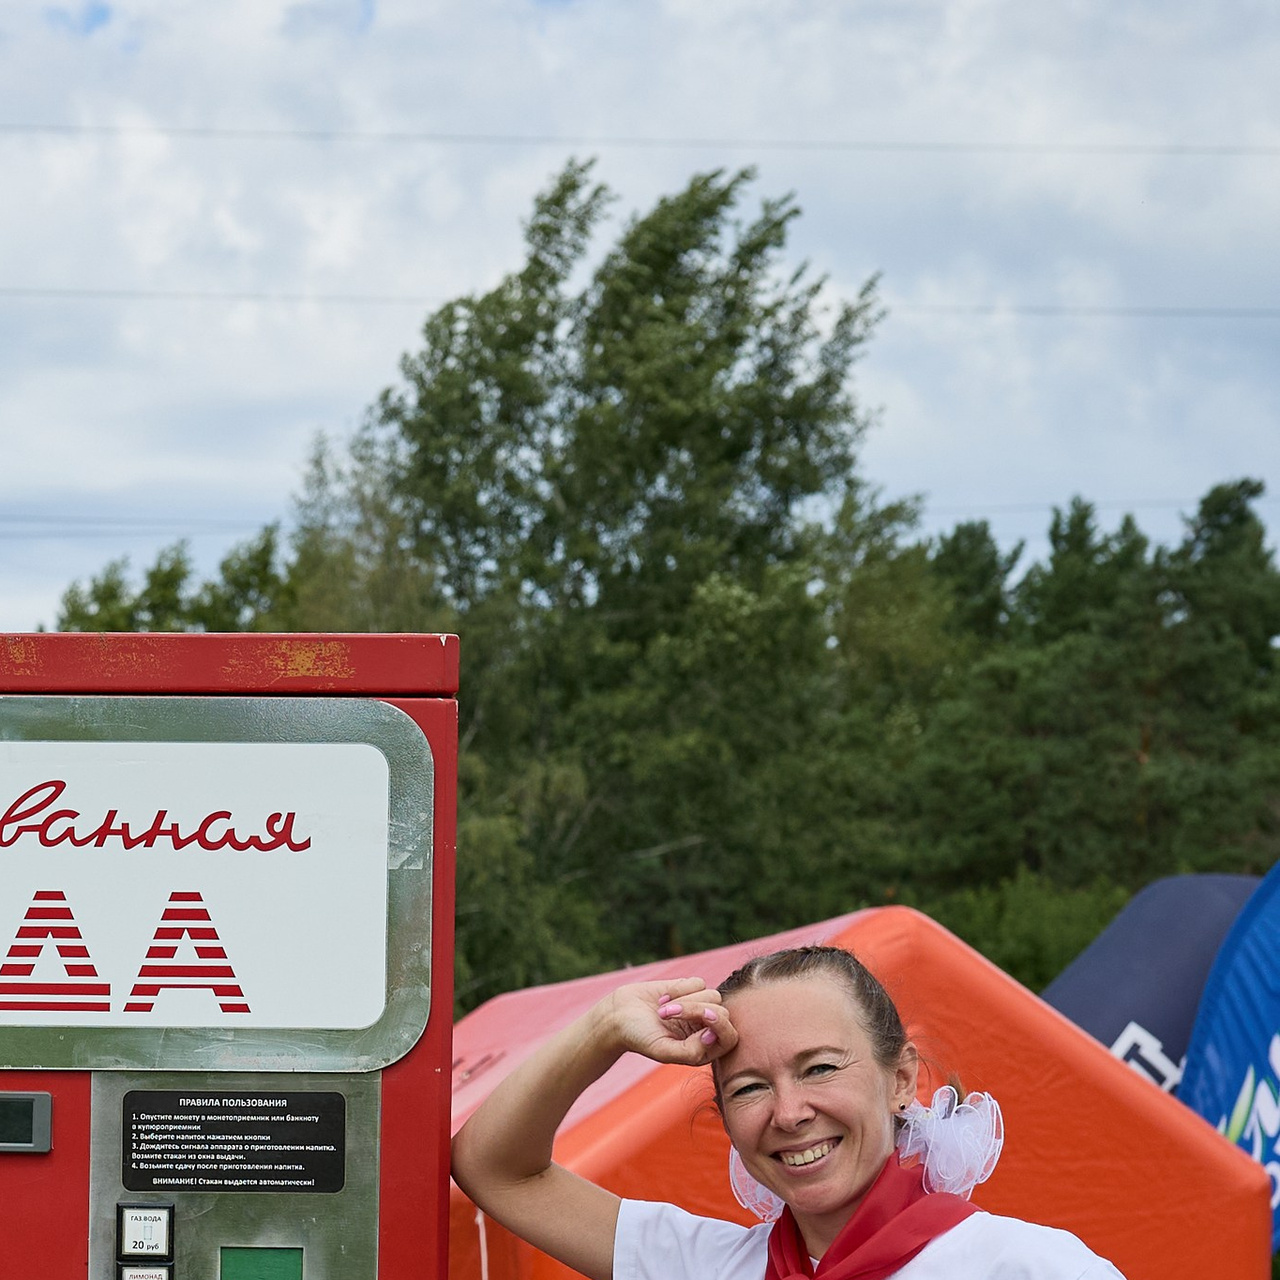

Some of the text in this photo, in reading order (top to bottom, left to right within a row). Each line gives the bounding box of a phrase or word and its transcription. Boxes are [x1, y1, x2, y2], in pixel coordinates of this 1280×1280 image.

[179, 1099, 287, 1107] ПРАВИЛА ПОЛЬЗОВАНИЯ
[140, 1113, 172, 1121] Опустите
[286, 1114, 319, 1122] банкноту
[140, 1133, 175, 1141] Выберите
[132, 1240, 144, 1250] 20
